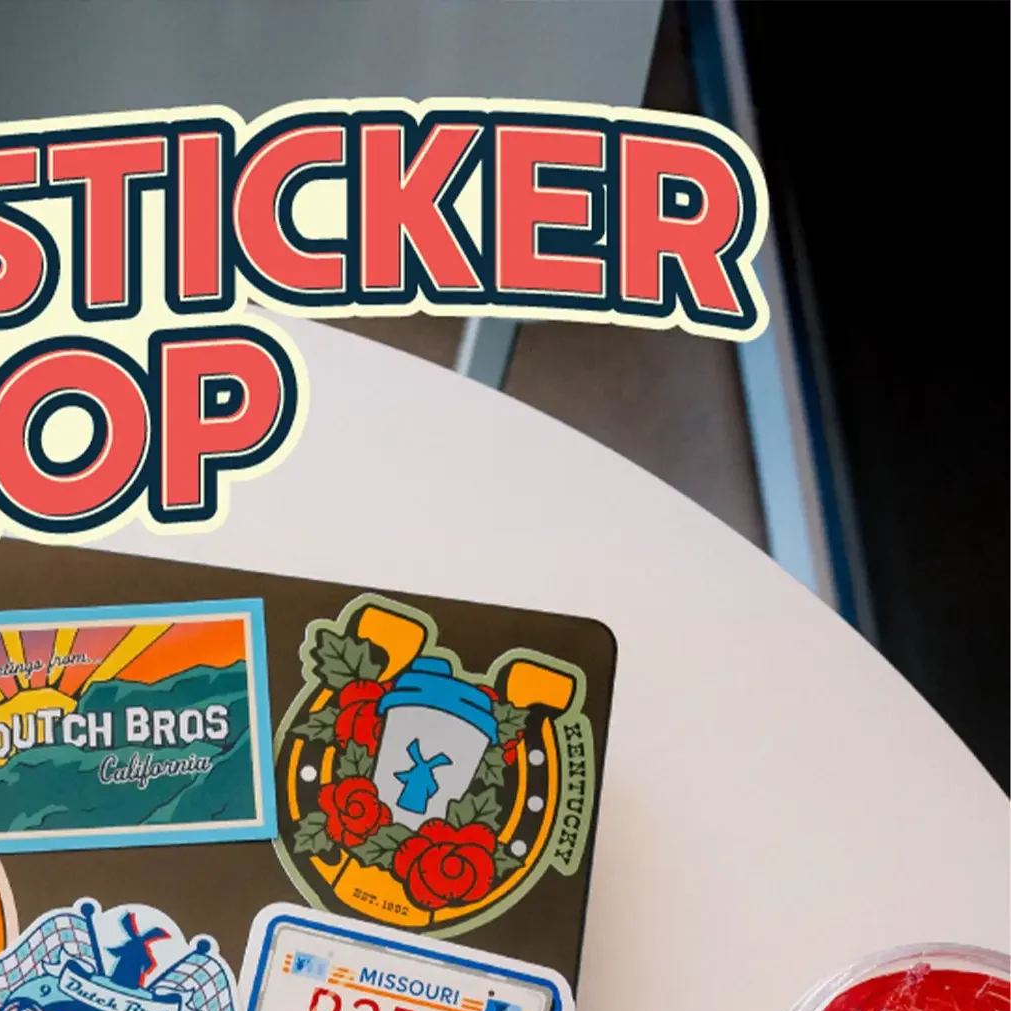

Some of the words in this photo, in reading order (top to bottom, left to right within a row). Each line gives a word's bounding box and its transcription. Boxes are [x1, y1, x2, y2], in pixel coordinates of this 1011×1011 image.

[126, 705, 229, 745] BROS
[100, 752, 212, 788] California
[556, 722, 587, 865] KENTUCKY
[40, 984, 52, 998] 9
[66, 978, 117, 1011] Dutch
[358, 967, 460, 1006] MISSOURI
